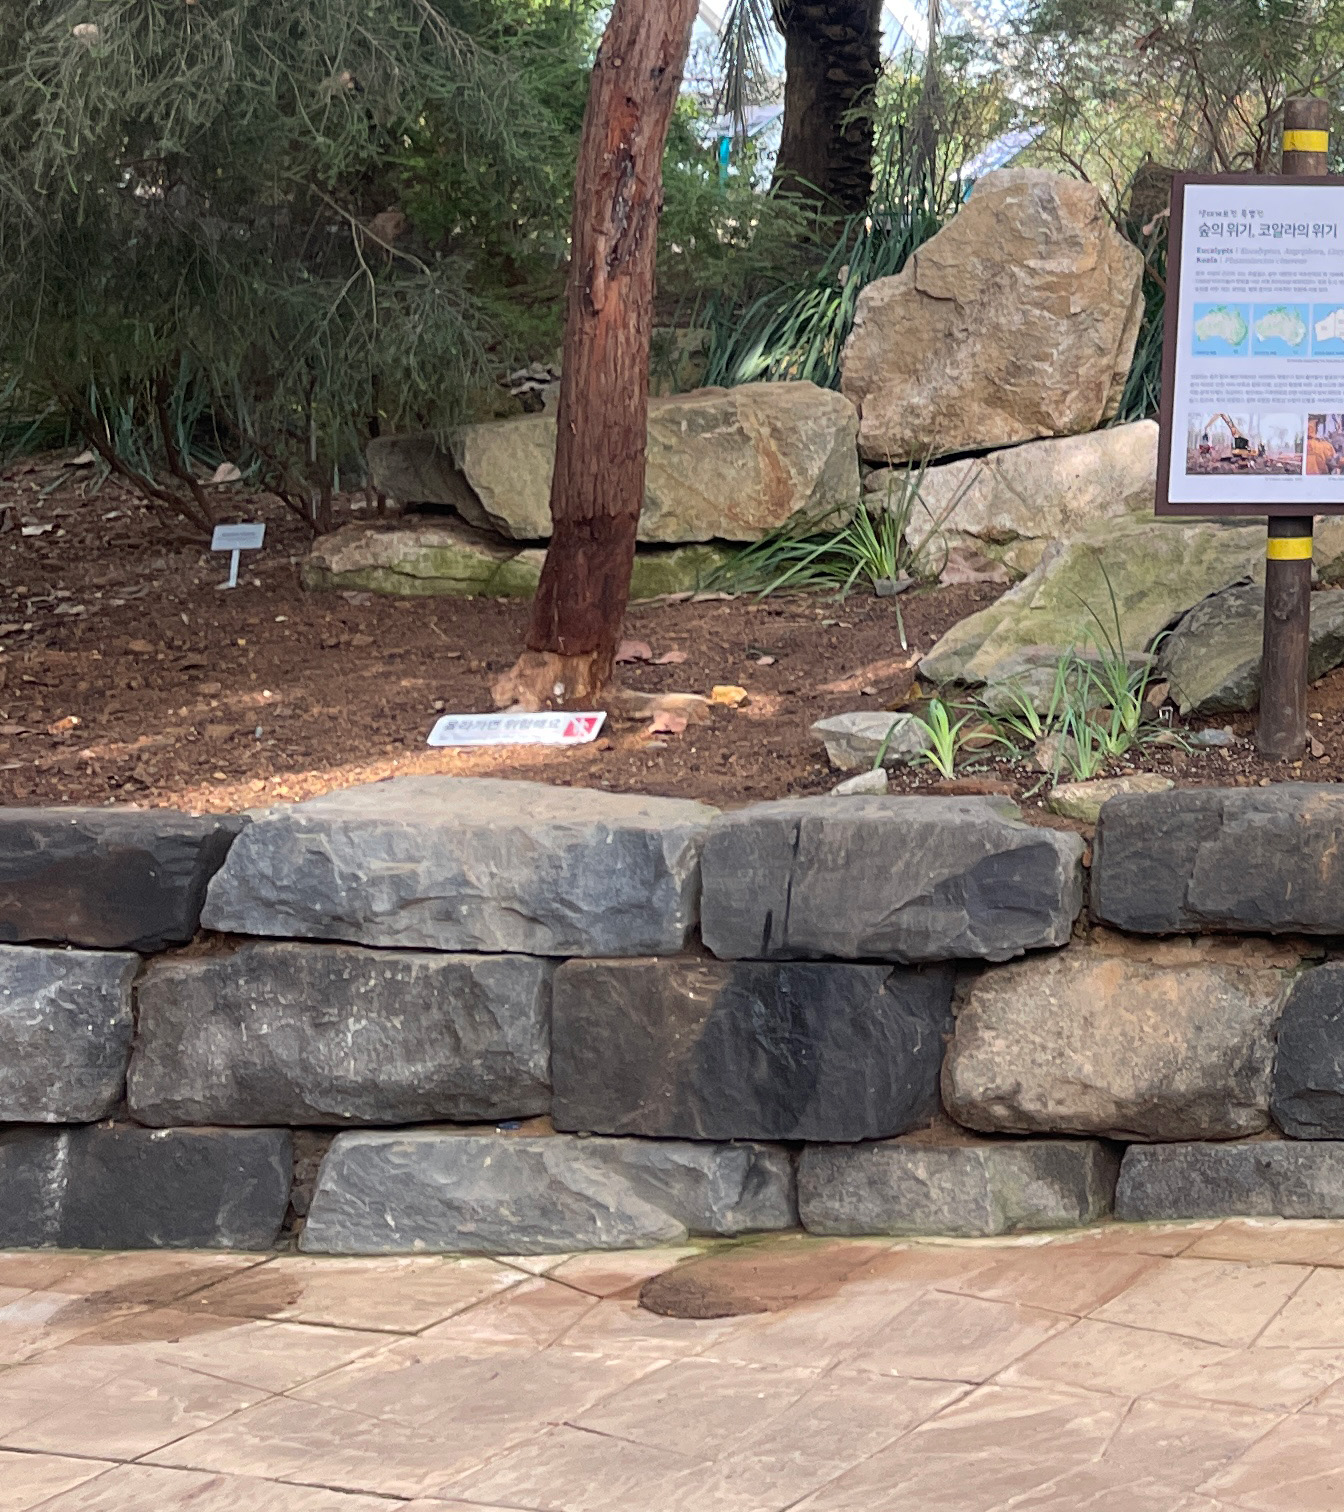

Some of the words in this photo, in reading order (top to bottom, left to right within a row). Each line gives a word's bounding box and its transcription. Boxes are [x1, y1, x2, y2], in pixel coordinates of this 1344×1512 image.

[1199, 222, 1224, 238] 숲의
[1258, 222, 1310, 239] 코알라의
[1312, 223, 1338, 239] 위기
[1196, 246, 1233, 256] Eucalypts
